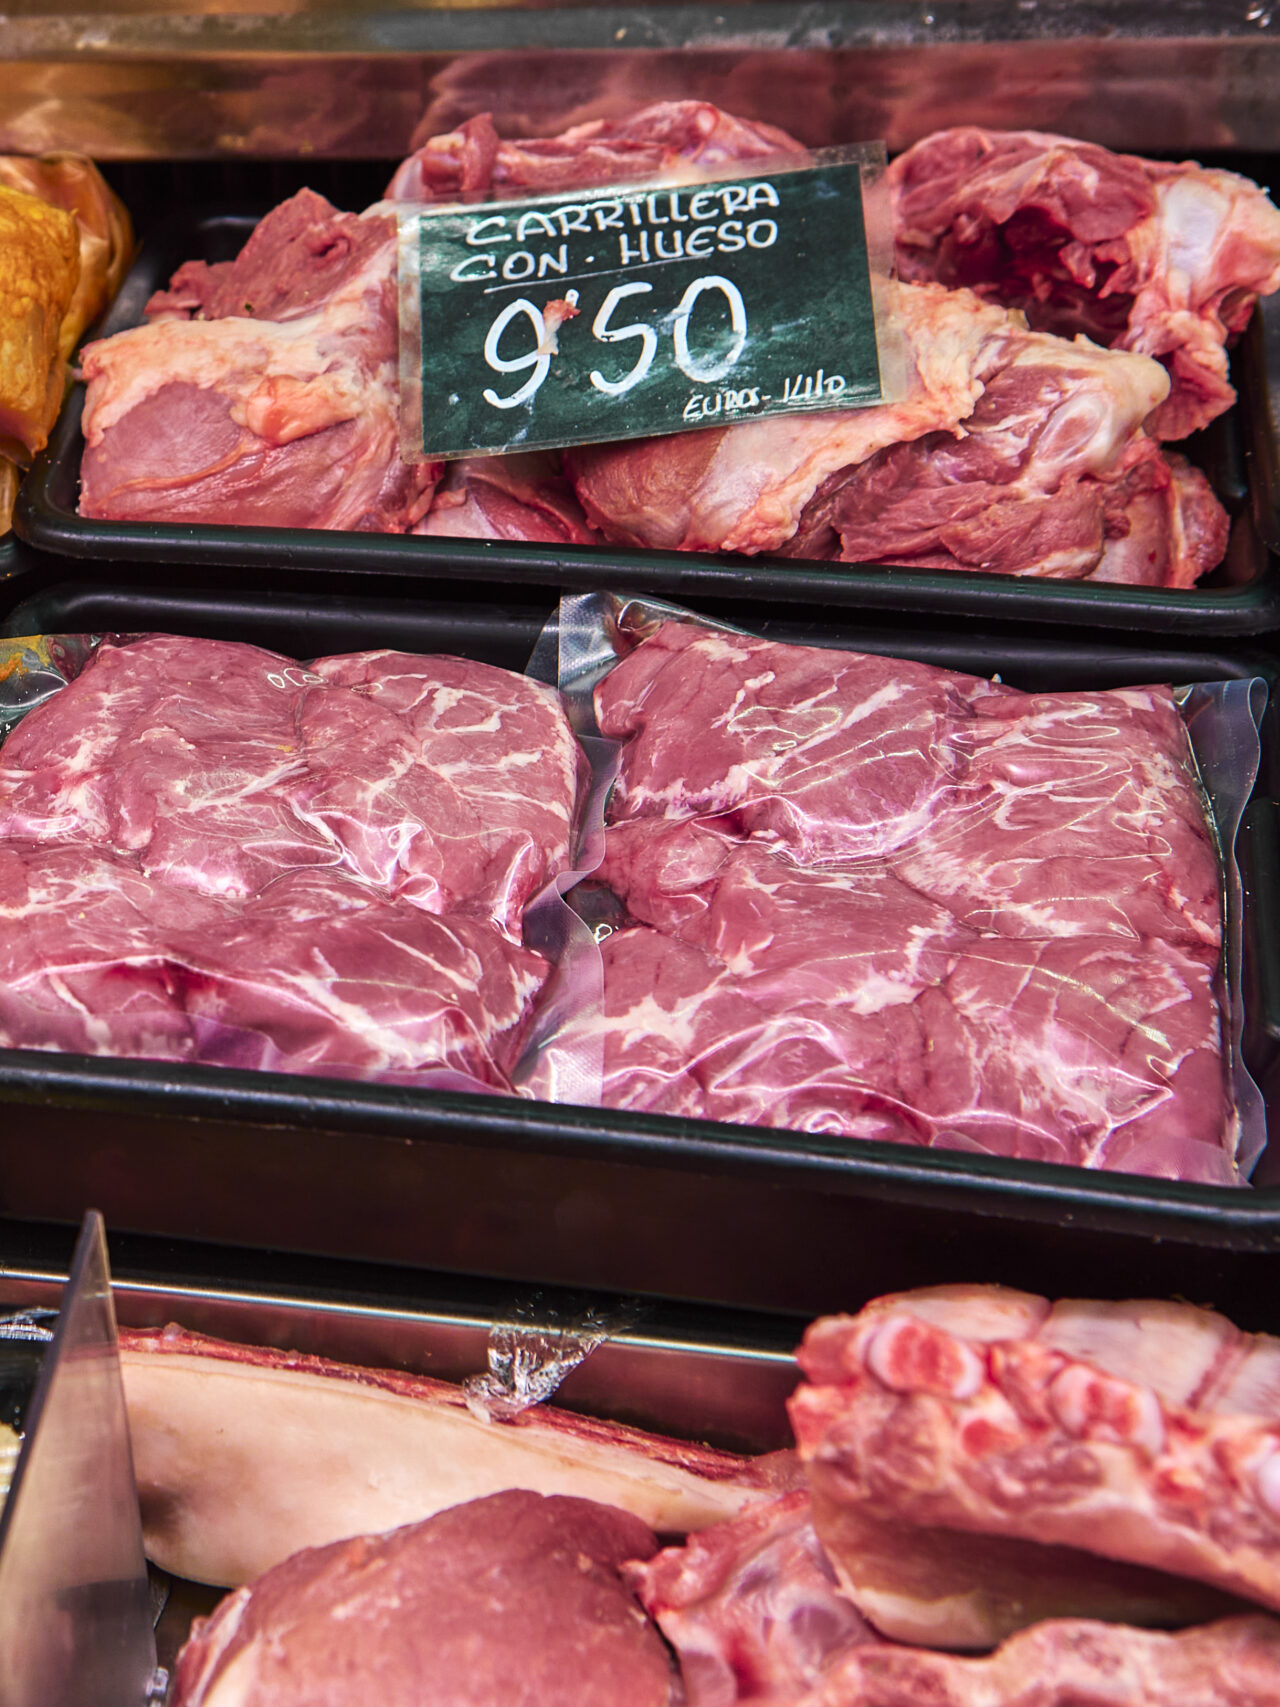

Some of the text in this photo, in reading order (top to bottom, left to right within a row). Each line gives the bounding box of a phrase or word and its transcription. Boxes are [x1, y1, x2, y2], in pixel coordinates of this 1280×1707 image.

[465, 182, 781, 246] CARRILLERA
[449, 218, 778, 282] CON HUESO
[482, 275, 748, 410] 9'50
